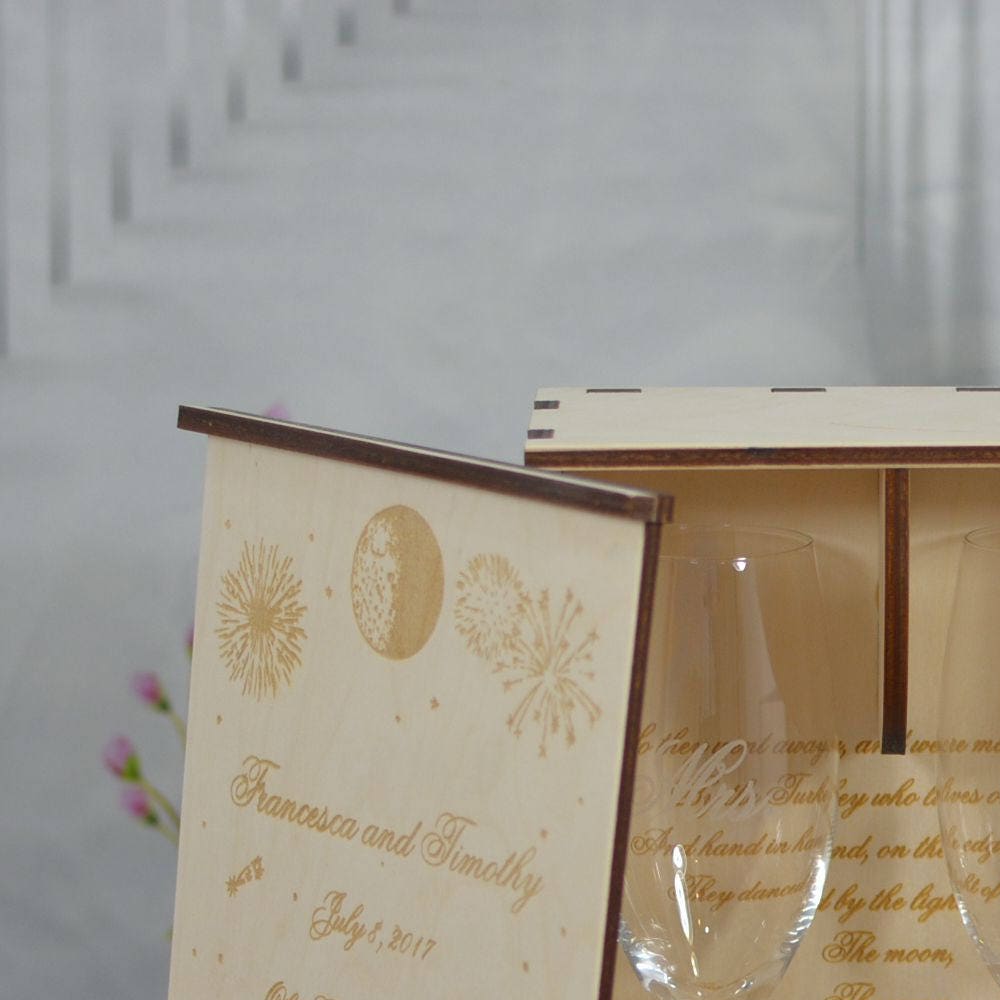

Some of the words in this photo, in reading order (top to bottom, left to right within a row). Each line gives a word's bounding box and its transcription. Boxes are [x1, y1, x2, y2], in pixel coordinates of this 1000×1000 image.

[871, 778, 919, 807] who
[230, 755, 360, 842] Francesca
[361, 821, 424, 858] and
[420, 812, 544, 915] Timothy
[697, 830, 761, 858] hand
[764, 837, 791, 854] in
[876, 844, 909, 860] on
[834, 883, 867, 925] by
[867, 883, 906, 912] the
[309, 890, 367, 952] July
[387, 923, 438, 961] 2017
[822, 930, 878, 964] The
[883, 949, 955, 968] moon,
